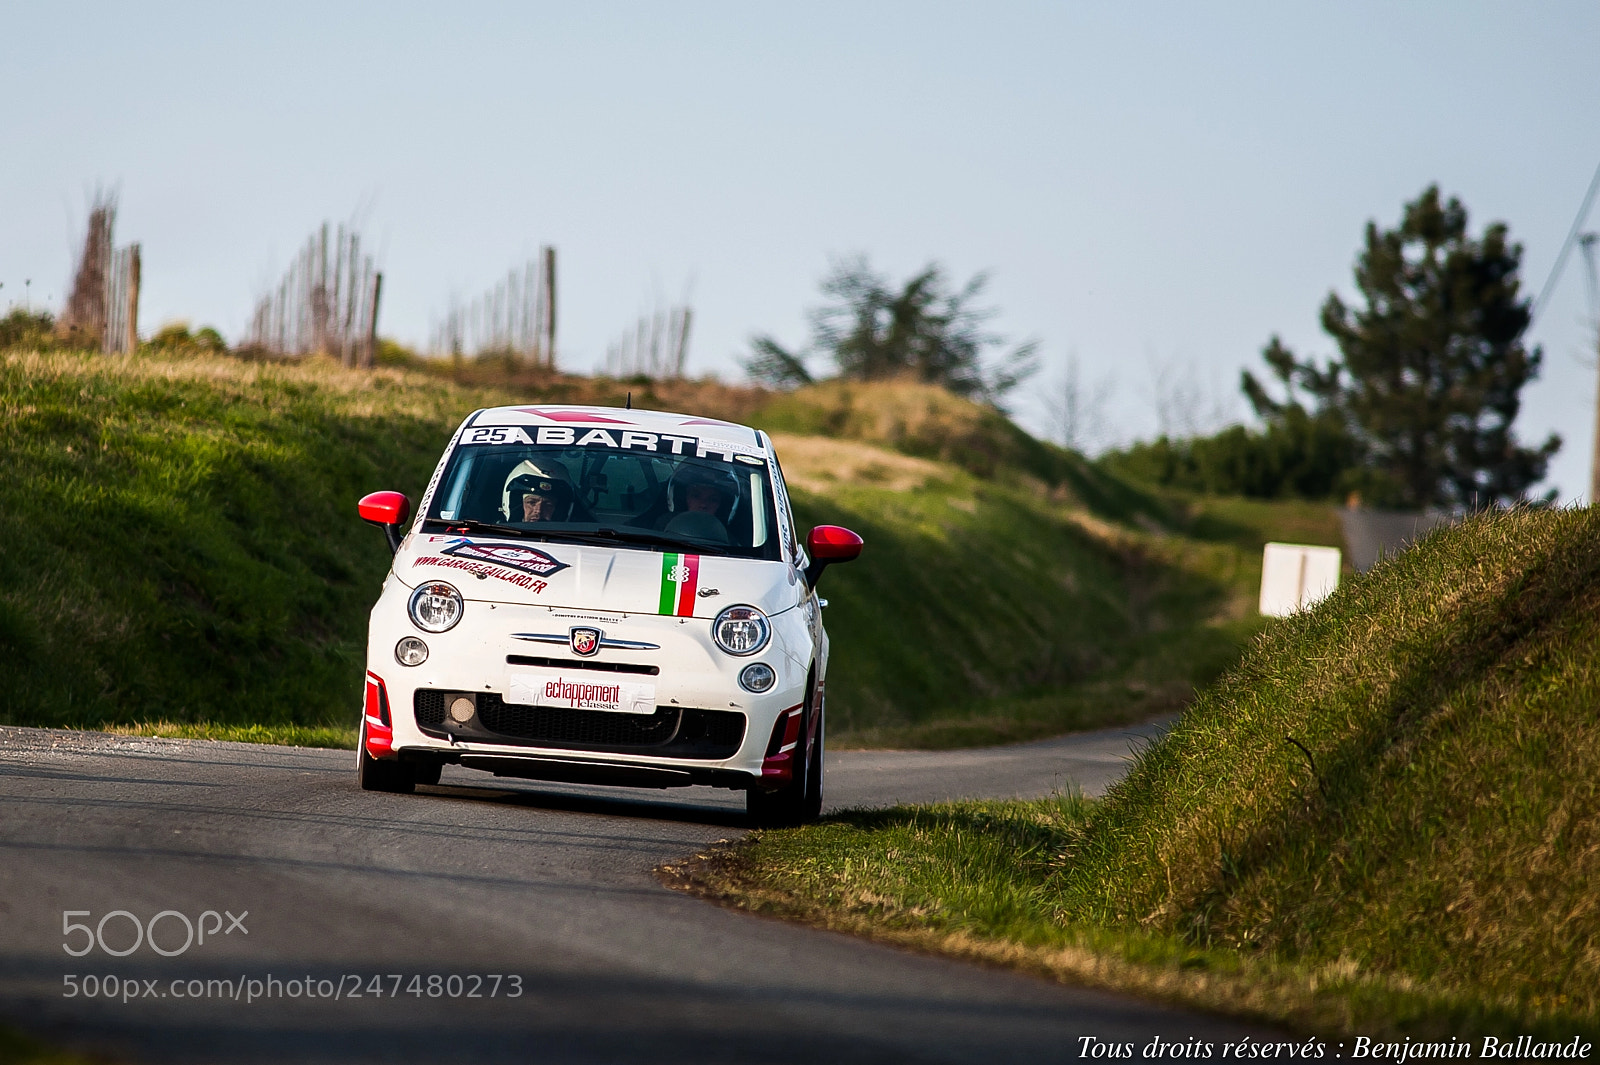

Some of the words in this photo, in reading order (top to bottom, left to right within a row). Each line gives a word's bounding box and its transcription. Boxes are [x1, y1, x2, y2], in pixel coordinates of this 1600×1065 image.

[471, 428, 509, 442] 25
[545, 676, 620, 708] echappement
[580, 699, 619, 710] classic
